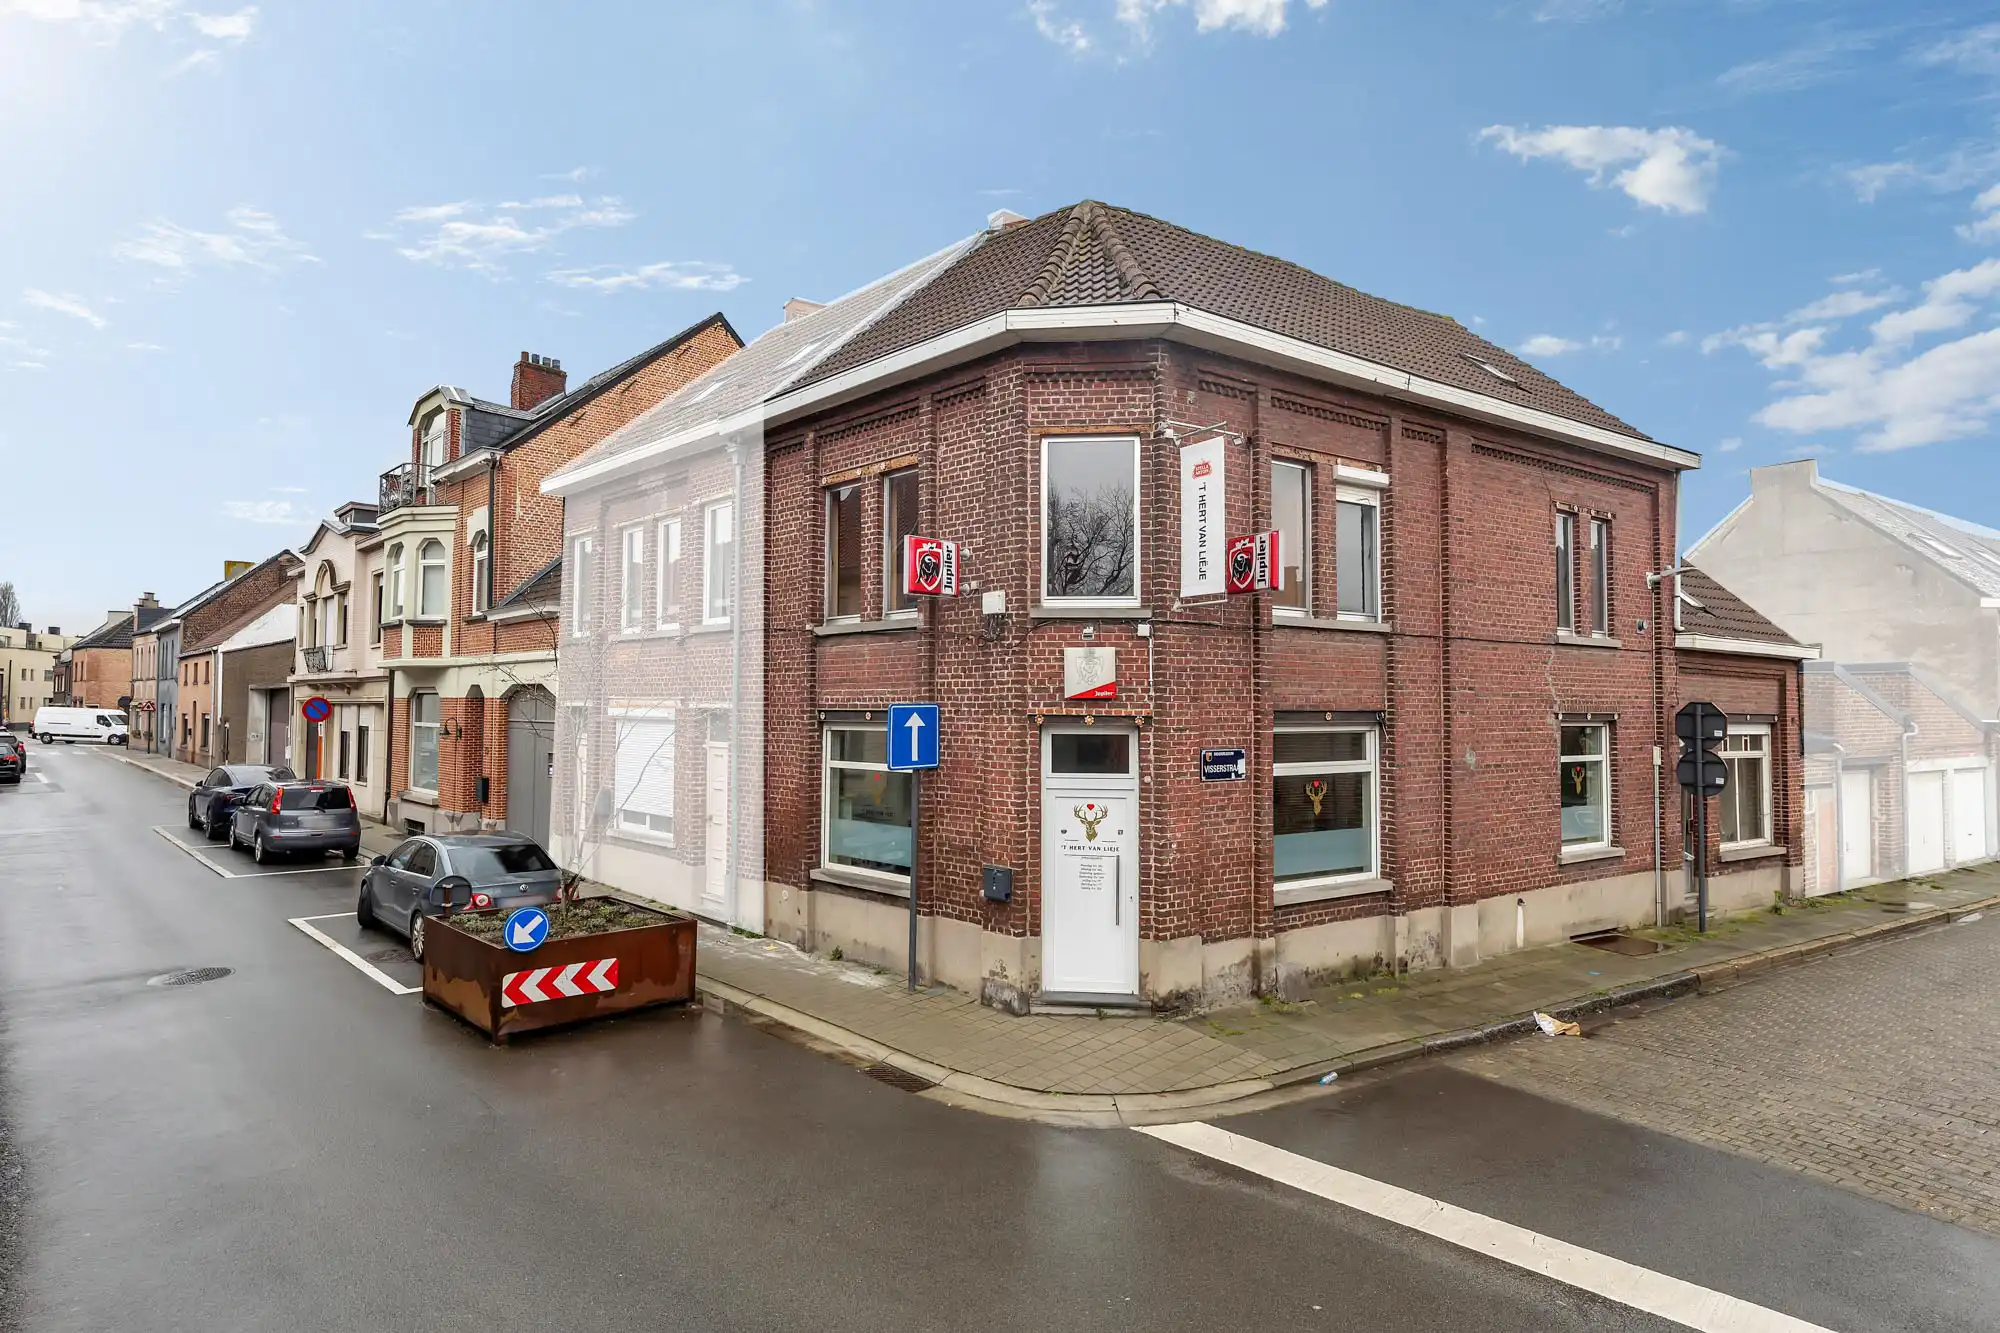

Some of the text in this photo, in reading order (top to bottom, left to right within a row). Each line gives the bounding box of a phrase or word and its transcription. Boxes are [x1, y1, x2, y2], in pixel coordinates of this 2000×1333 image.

[1198, 494, 1207, 524] HERT
[1198, 525, 1207, 548] VAN
[944, 545, 954, 592] Jupiler
[1198, 550, 1209, 581] LIËJE
[1257, 536, 1268, 587] Jupiler
